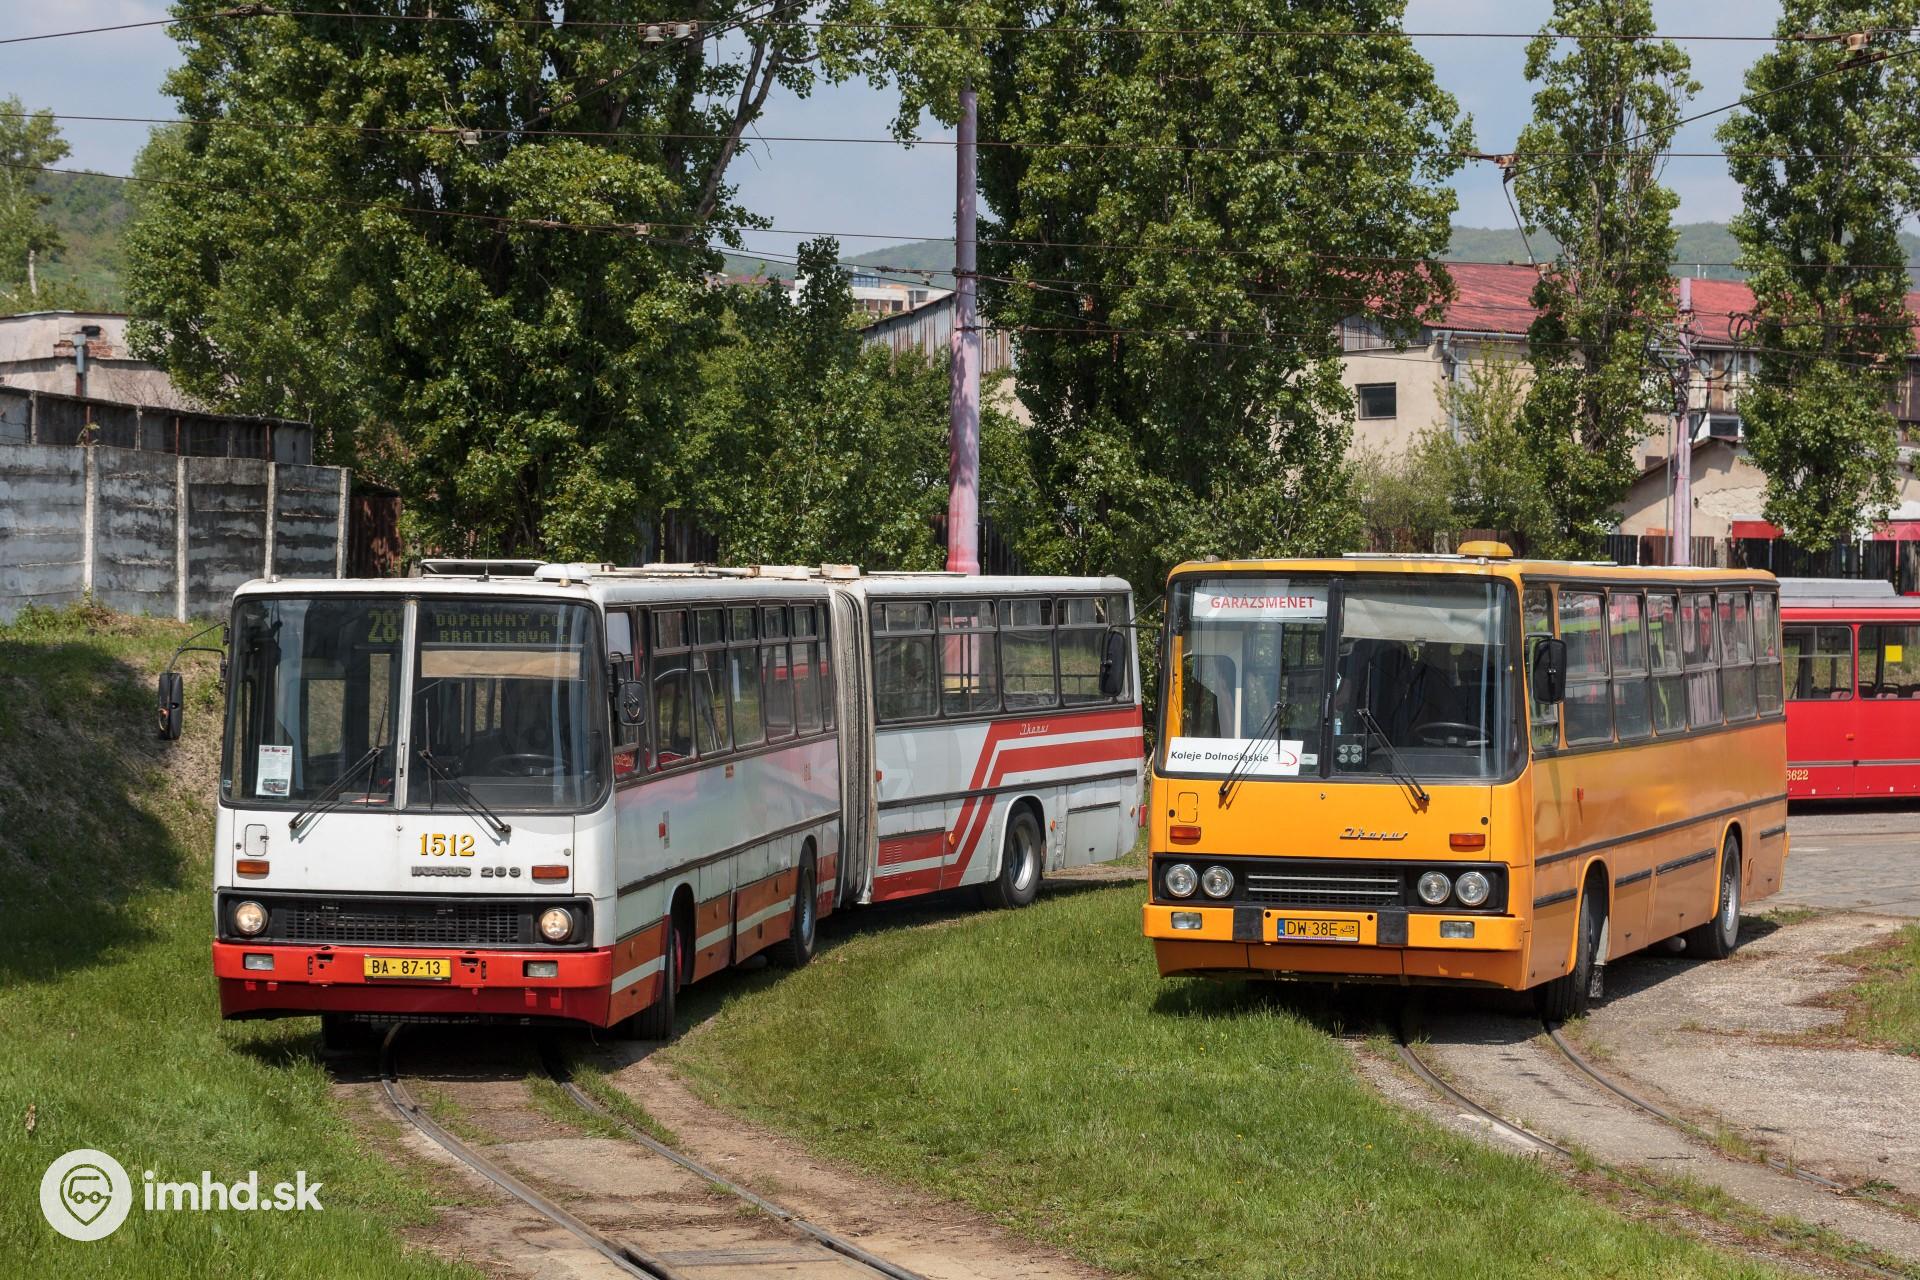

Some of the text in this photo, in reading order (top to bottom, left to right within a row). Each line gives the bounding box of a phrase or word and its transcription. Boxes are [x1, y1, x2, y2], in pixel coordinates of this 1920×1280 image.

[1210, 593, 1315, 609] GARÁZSMENET
[439, 630, 551, 643] BRATISLAVA
[1170, 751, 1202, 761] Koleje
[420, 832, 476, 857] 1512
[1287, 921, 1338, 937] DW 38E
